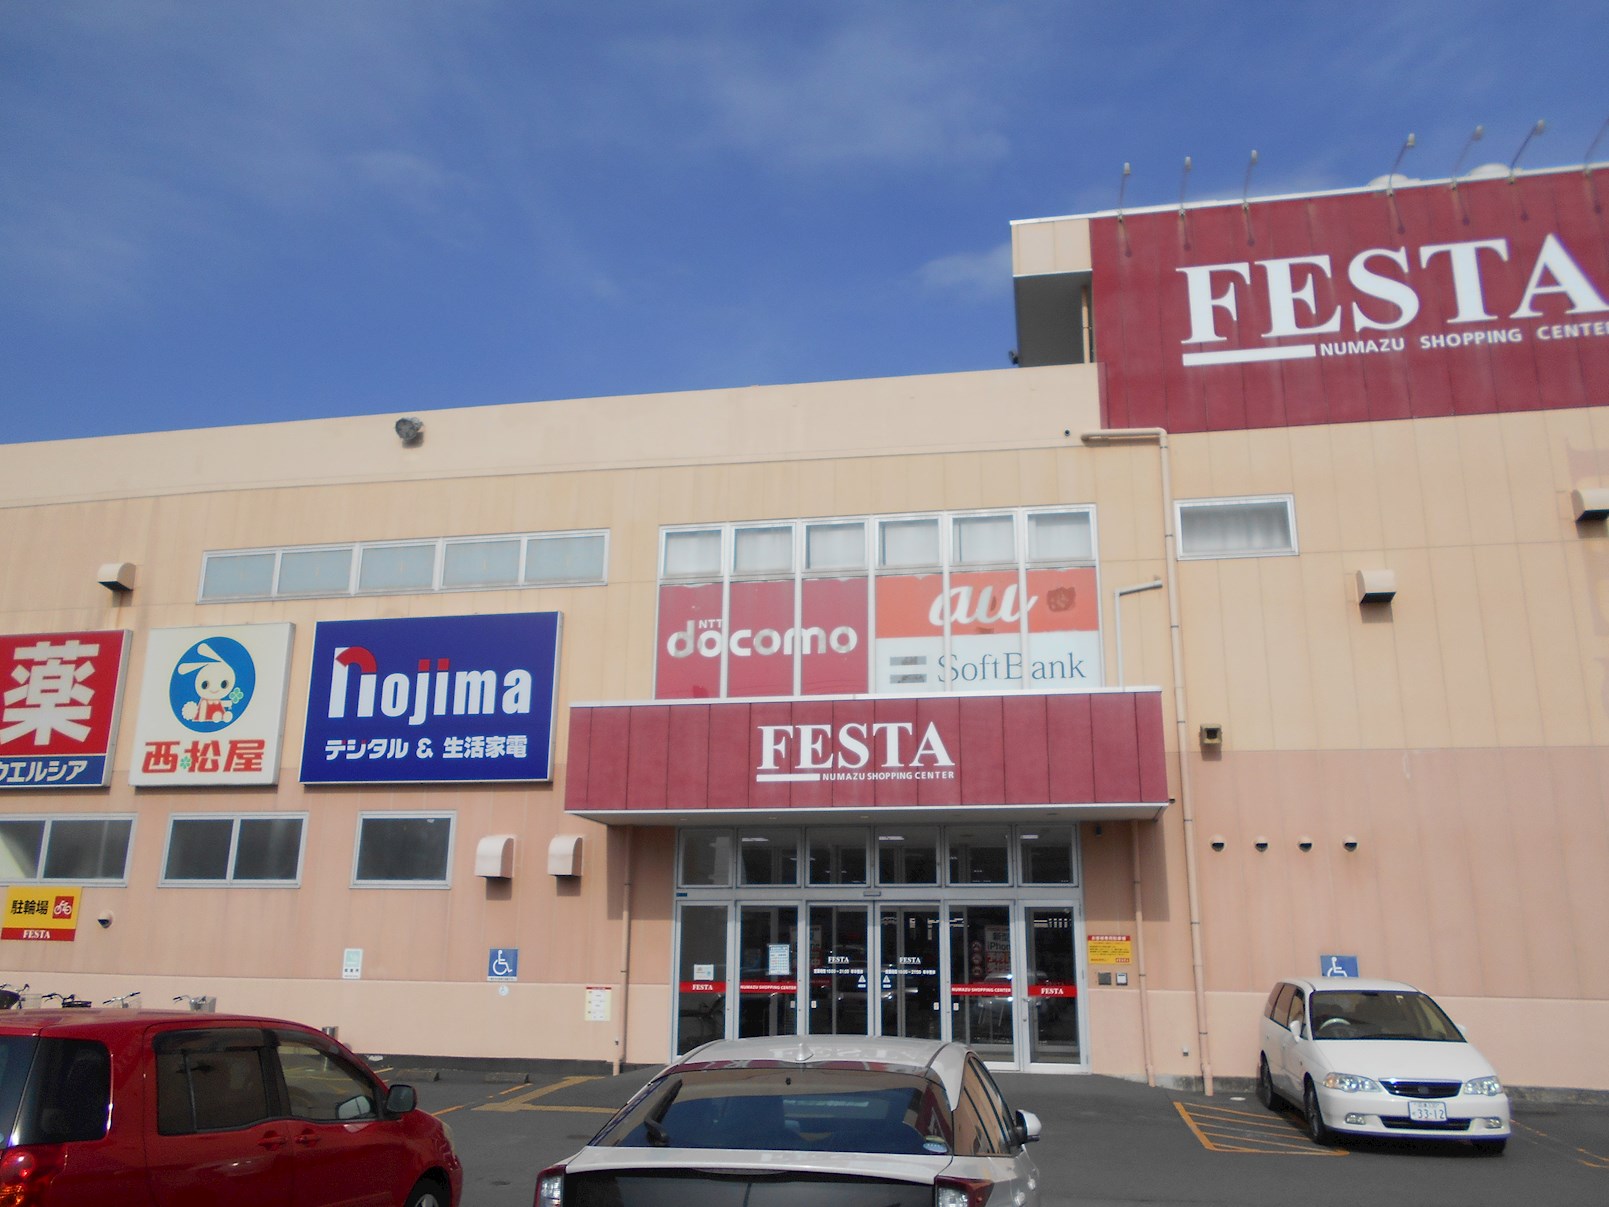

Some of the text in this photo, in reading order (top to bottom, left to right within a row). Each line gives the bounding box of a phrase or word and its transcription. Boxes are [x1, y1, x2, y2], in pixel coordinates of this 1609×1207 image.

[1175, 233, 1609, 344] FESTA
[1320, 321, 1609, 357] NUMAZU SHOPPING CENTE
[928, 583, 1038, 626] au
[667, 619, 858, 658] docomo
[698, 618, 725, 629] NTT
[937, 651, 1087, 683] SoftBank
[0, 639, 100, 746] 薬
[327, 645, 532, 726] nojima
[141, 739, 266, 774] 西松屋
[324, 735, 528, 761] デジタル & 生活家電
[756, 721, 955, 770] FESTA
[822, 771, 955, 781] NUMAZU SHOPPING CENTER
[11, 899, 49, 915] 駐輪場
[23, 929, 51, 939] FESTA
[828, 956, 849, 964] FESTA
[1418, 1109, 1444, 1119] 33-12
